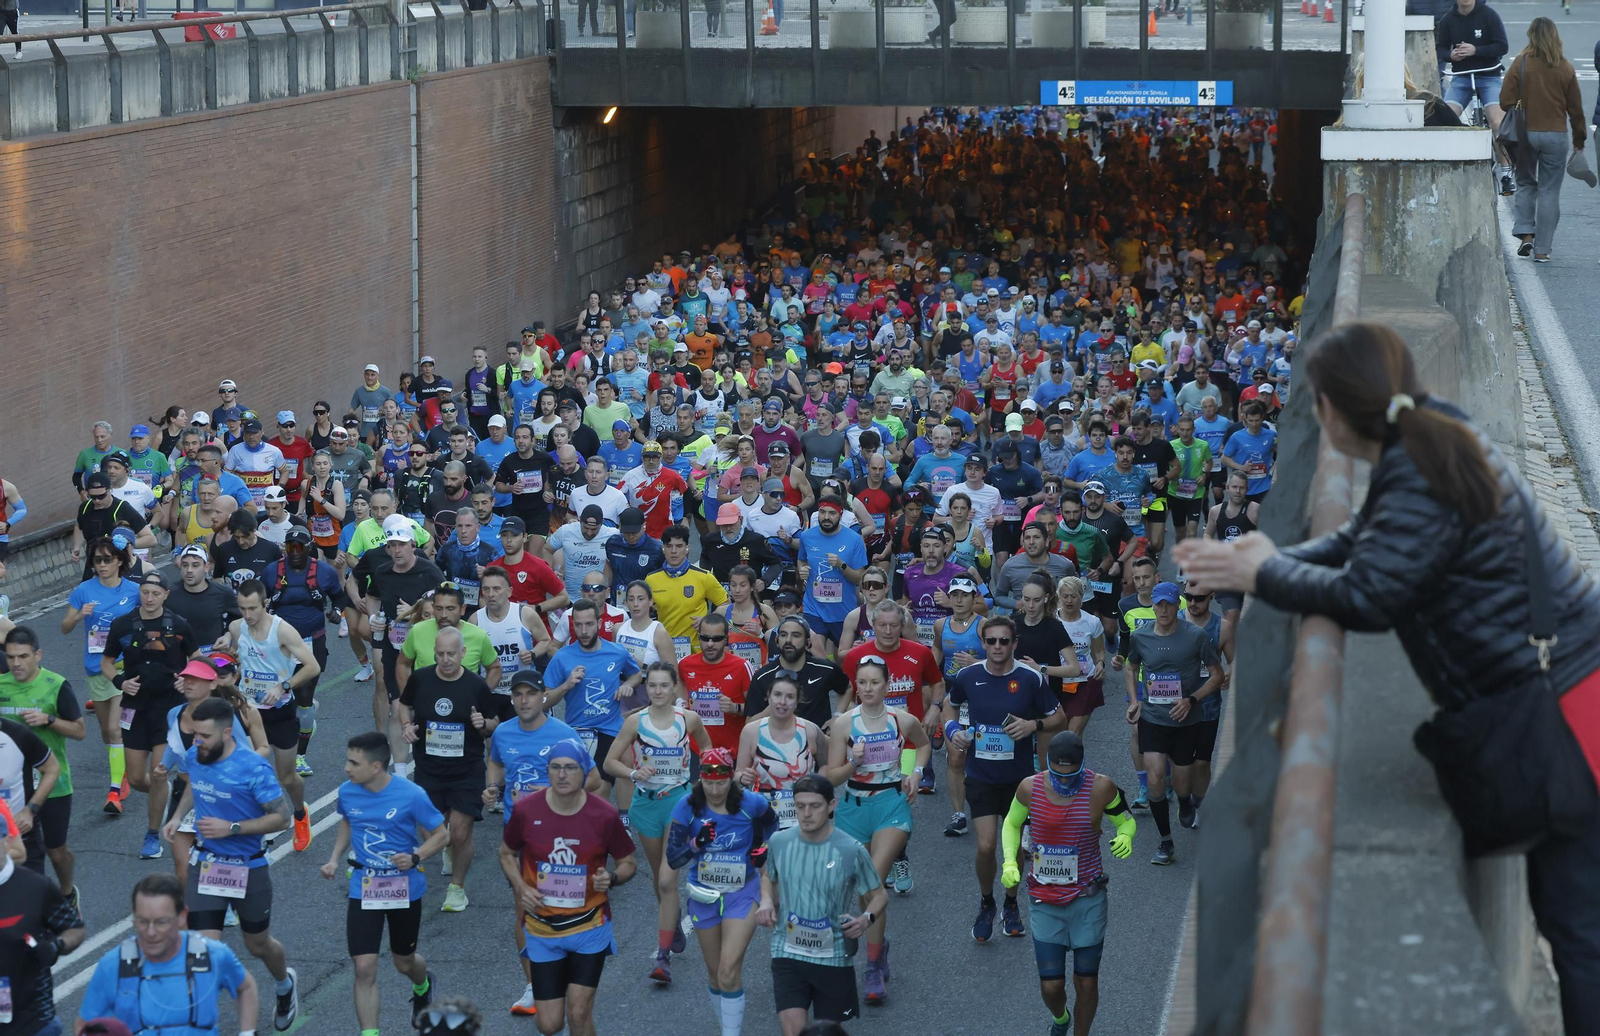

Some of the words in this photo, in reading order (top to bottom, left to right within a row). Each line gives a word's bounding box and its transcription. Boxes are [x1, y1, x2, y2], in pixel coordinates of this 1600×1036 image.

[1084, 95, 1135, 104] DELEGACIÓN
[1135, 96, 1146, 104] DE
[1147, 96, 1191, 104] MOVILIDAD
[555, 480, 576, 492] 1519
[1151, 689, 1179, 697] JOAQUIM
[868, 733, 892, 741] ZURICH
[869, 745, 885, 753] 10020
[985, 744, 1003, 752] NICO
[714, 854, 741, 862] ZURICH
[1039, 866, 1071, 876] ADRIÁN
[206, 876, 236, 887] GUADIX
[701, 874, 742, 885] ISABELLA
[363, 888, 408, 899] ALVARASO
[801, 919, 826, 928] ZURICH
[795, 936, 823, 948] DAVID
